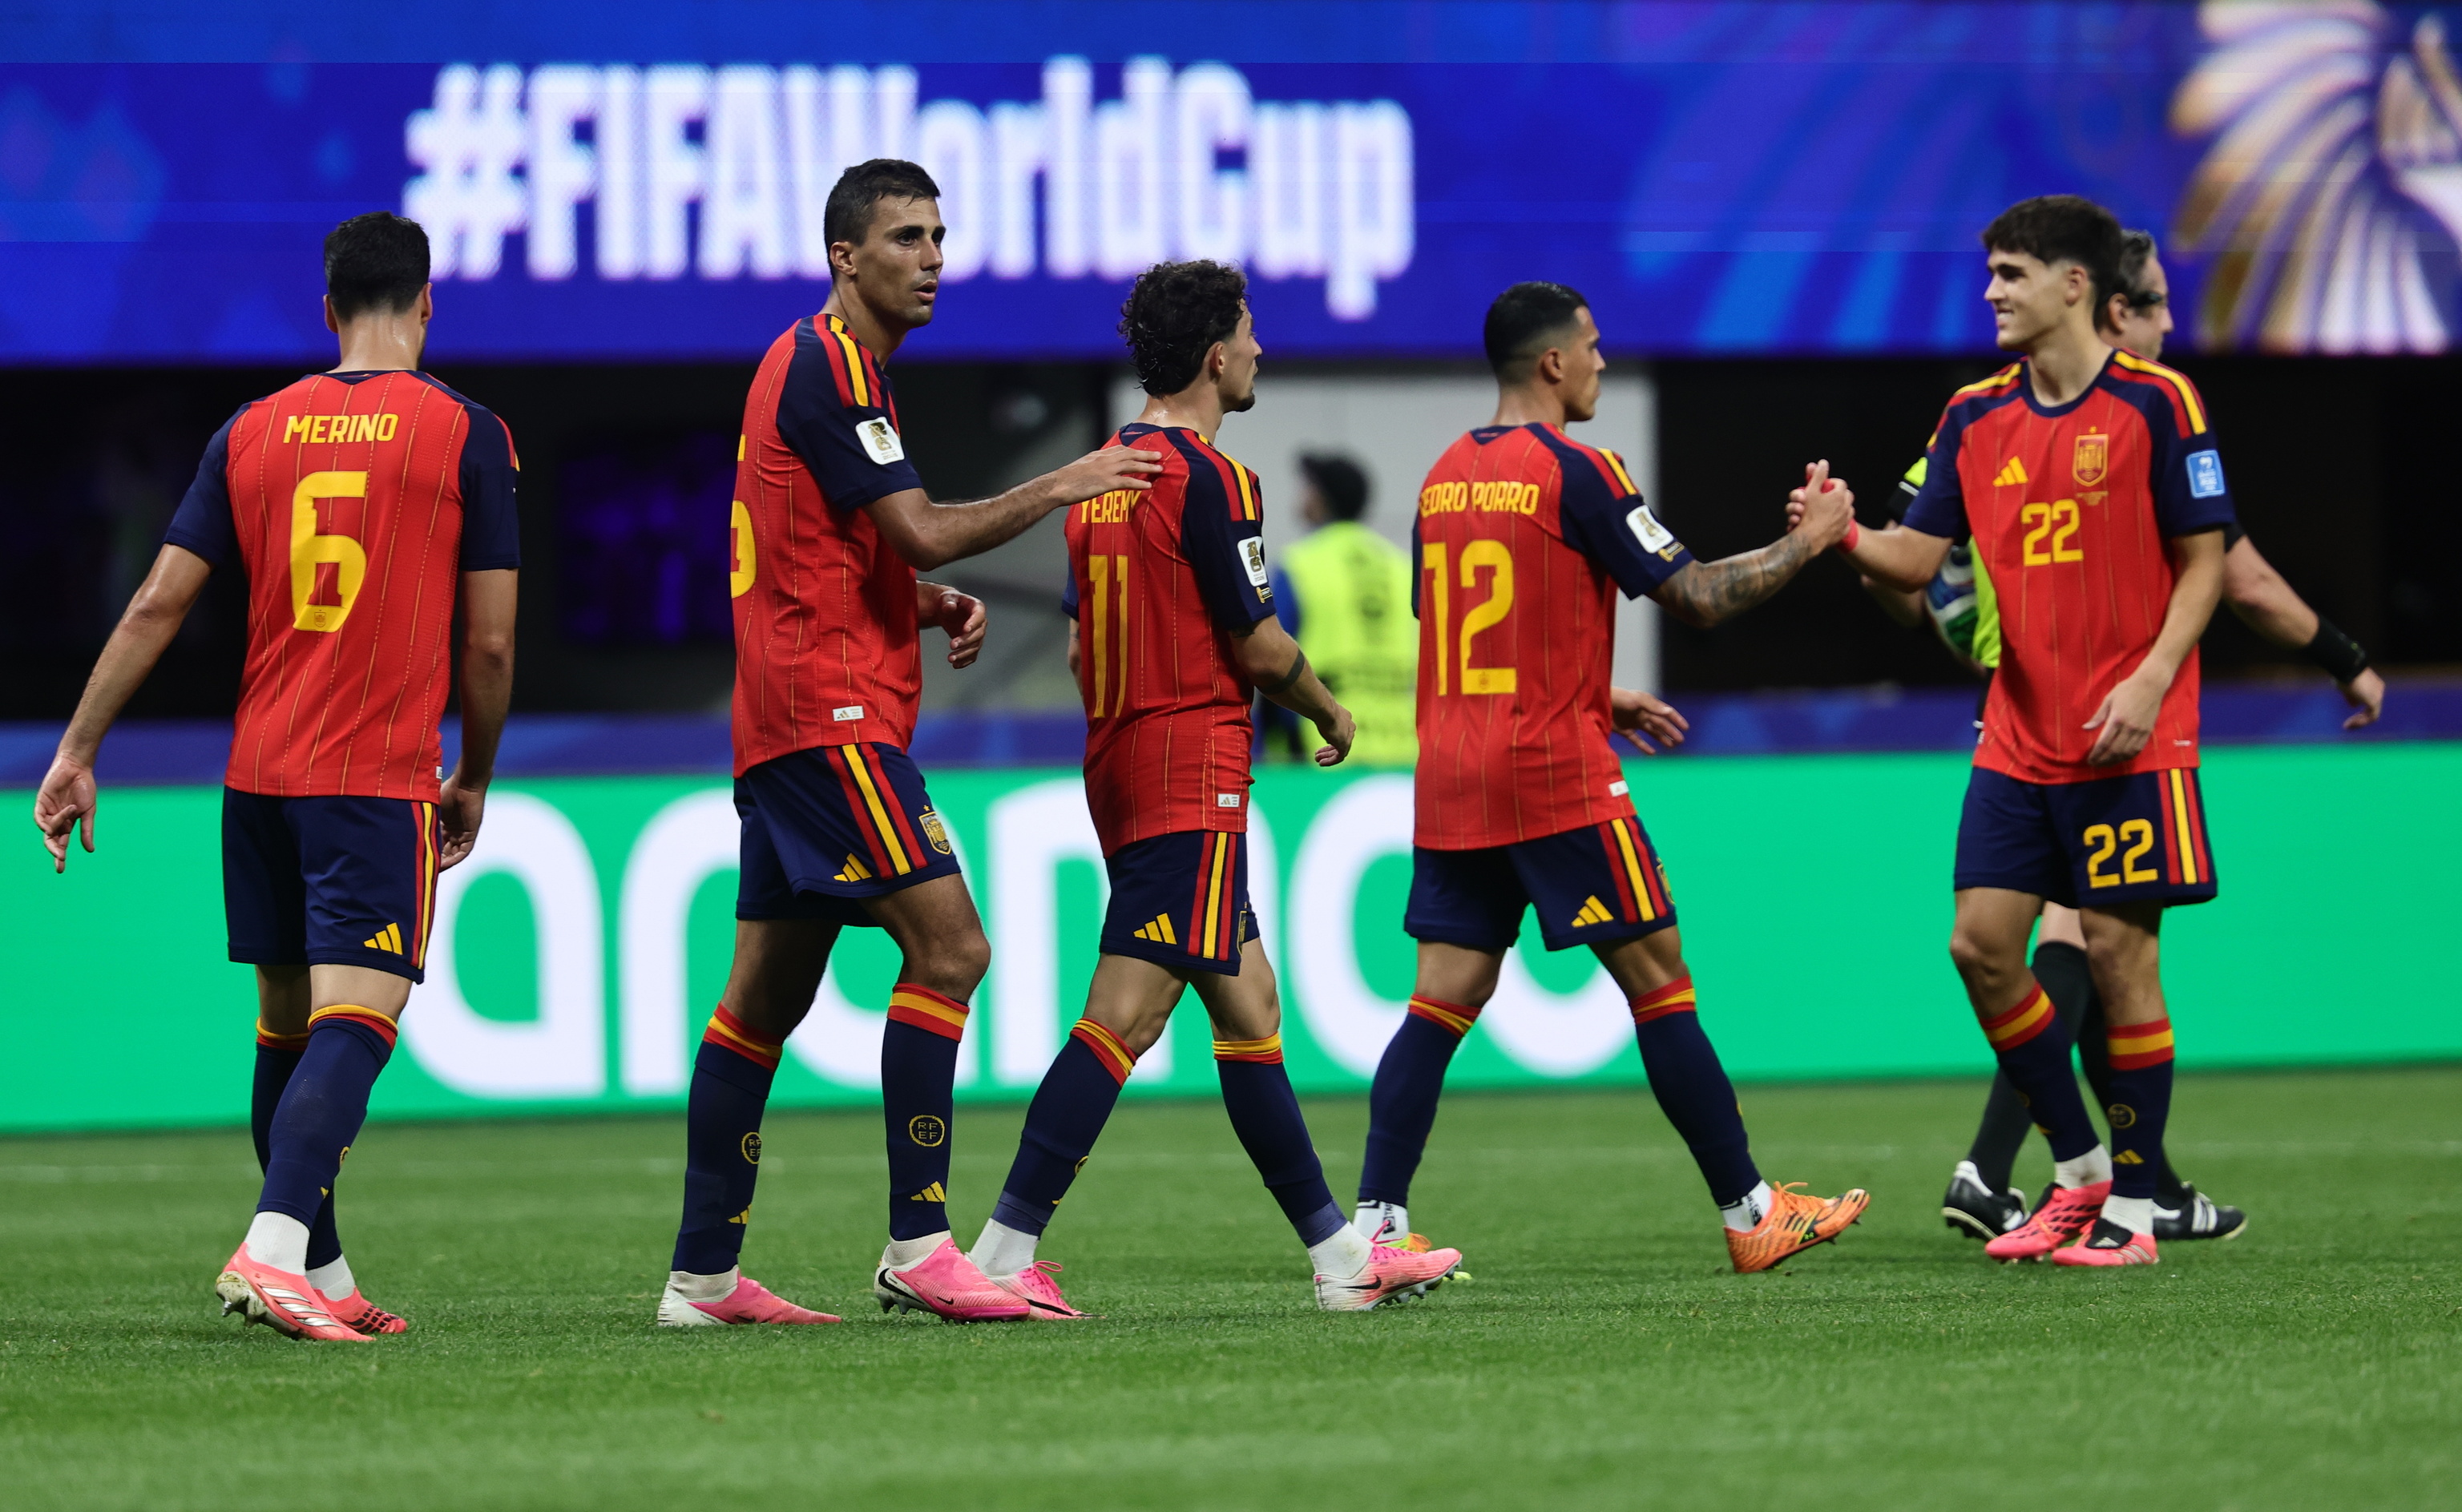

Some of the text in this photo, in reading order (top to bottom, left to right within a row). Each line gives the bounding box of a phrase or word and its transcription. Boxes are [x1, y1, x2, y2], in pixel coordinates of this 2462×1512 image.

[402, 54, 1413, 319] #FIFAWorldCup
[283, 413, 399, 444] MERINO
[290, 470, 369, 633] 6
[1471, 481, 1540, 516] PORRO
[2021, 498, 2084, 566] 22
[1089, 554, 1128, 718] 11
[1423, 539, 1517, 696] 12
[2083, 818, 2159, 889] 22
